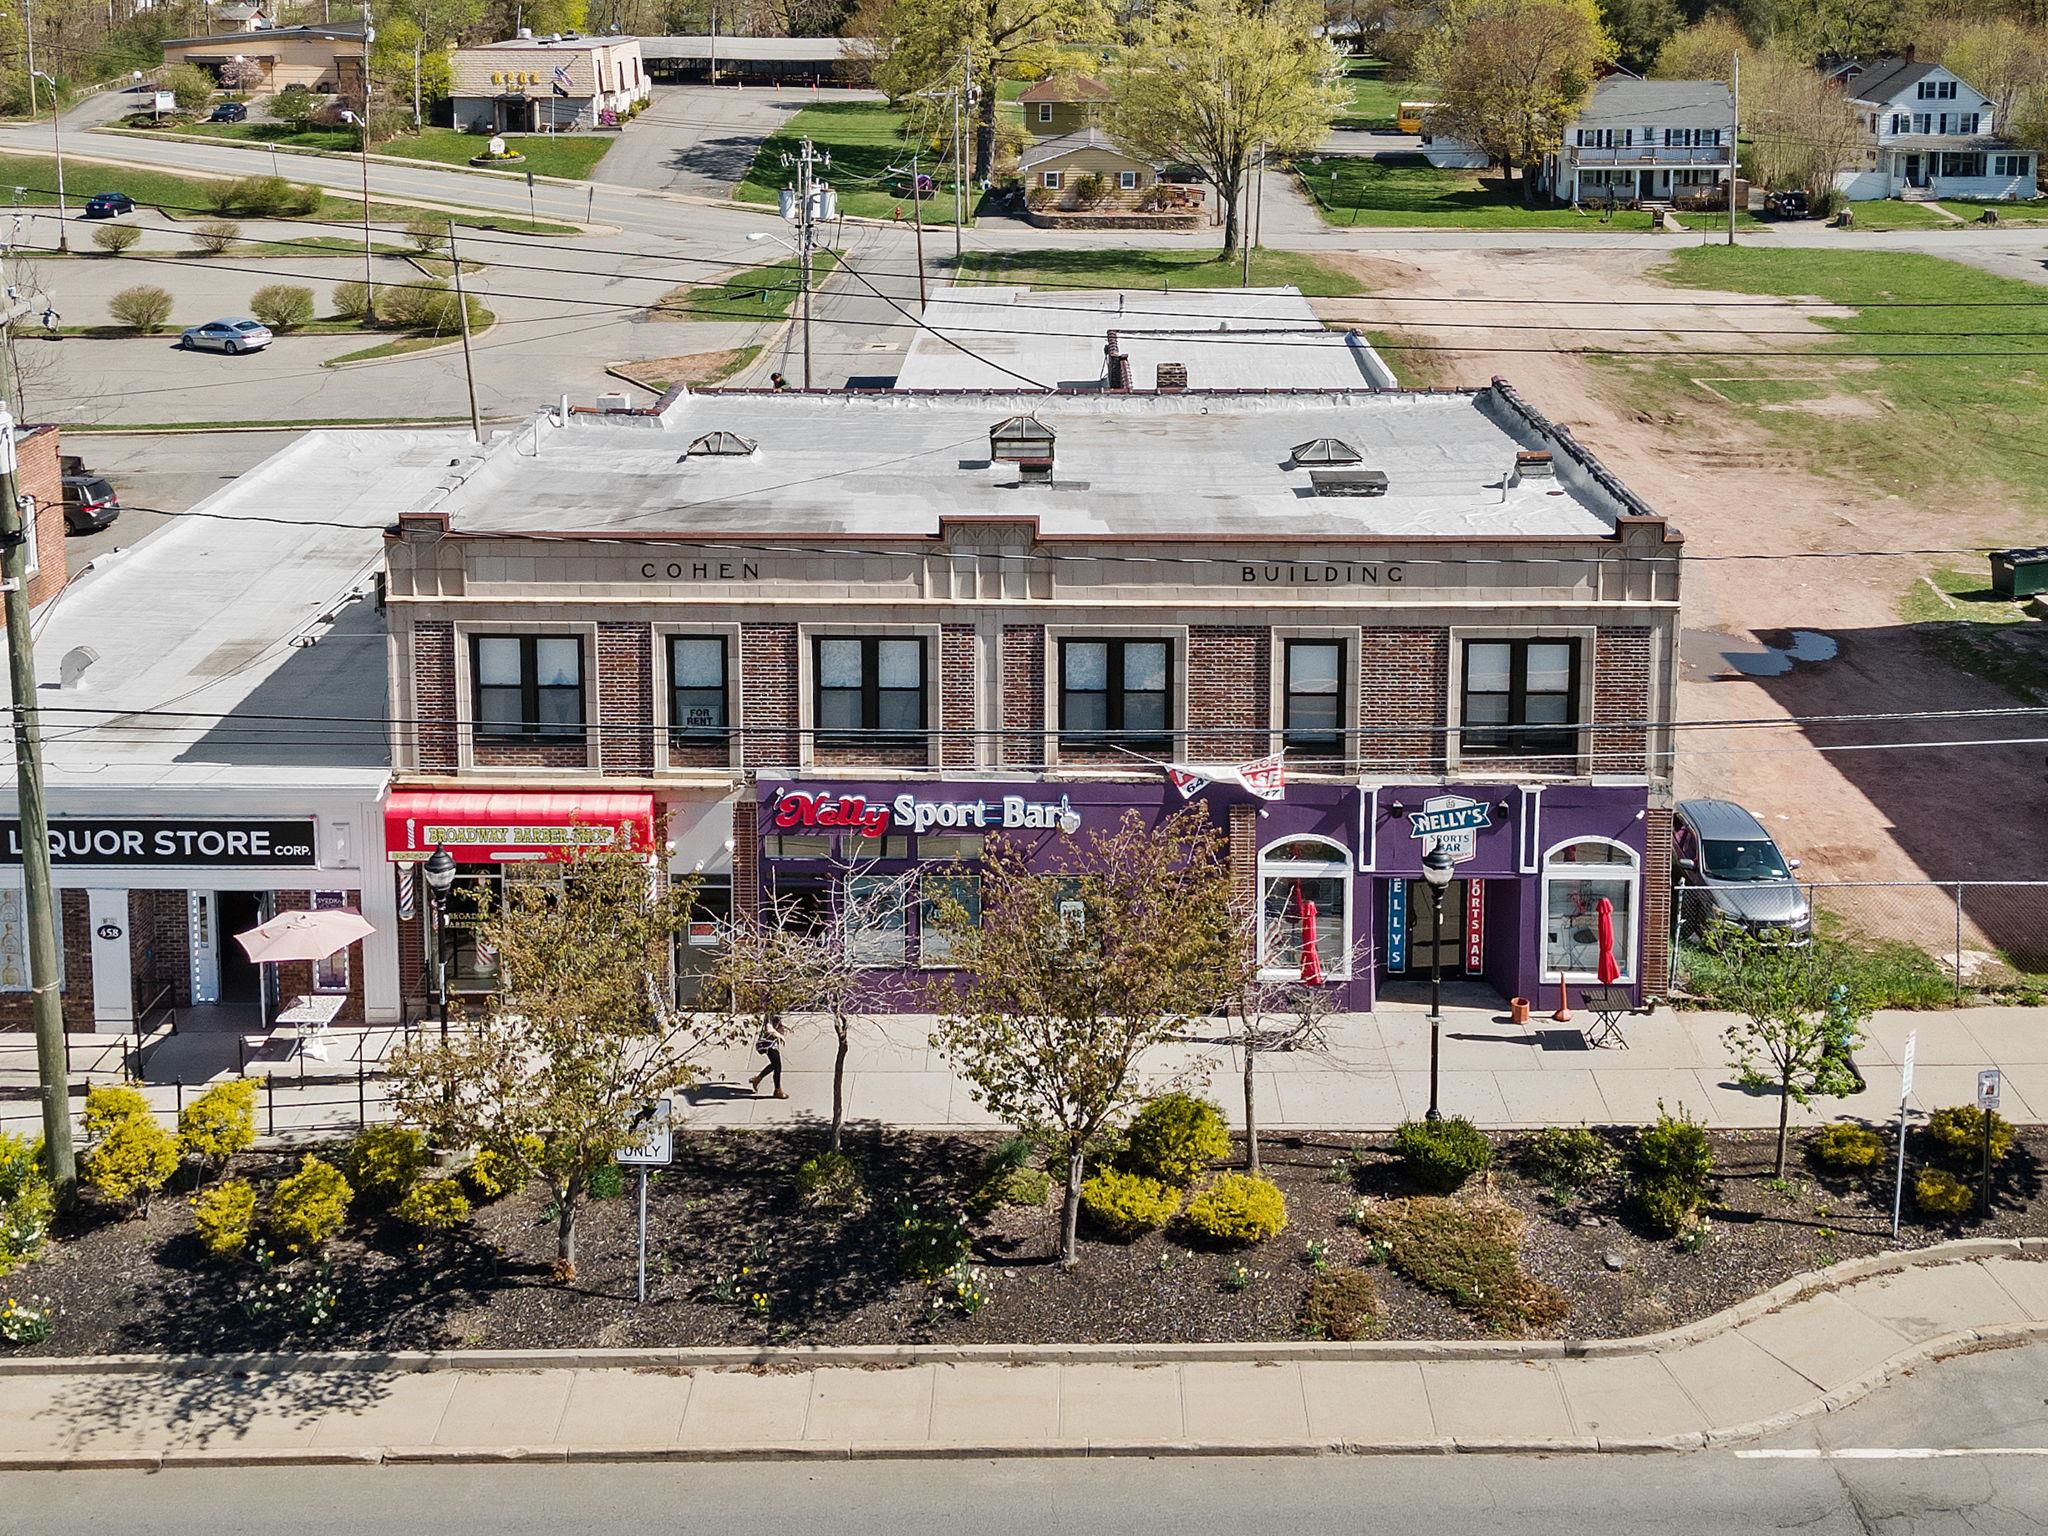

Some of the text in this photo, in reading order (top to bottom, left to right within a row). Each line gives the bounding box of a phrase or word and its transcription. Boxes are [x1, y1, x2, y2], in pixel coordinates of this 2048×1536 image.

[641, 563, 1403, 582] COHEN BUILDING
[689, 708, 711, 717] FOR
[686, 717, 713, 726] RENT
[775, 790, 1063, 838] Nelly Sport Bar
[1418, 808, 1483, 832] NELLY'S
[9, 830, 312, 857] LQUOR STORE CORP.
[429, 828, 509, 843] BROADWAY
[514, 828, 568, 843] BARBER
[1430, 834, 1470, 843] SPORTS
[1392, 877, 1402, 963] ELLYS
[100, 928, 119, 938] 458
[1471, 934, 1480, 965] BAR
[624, 1146, 661, 1157] ONLY
